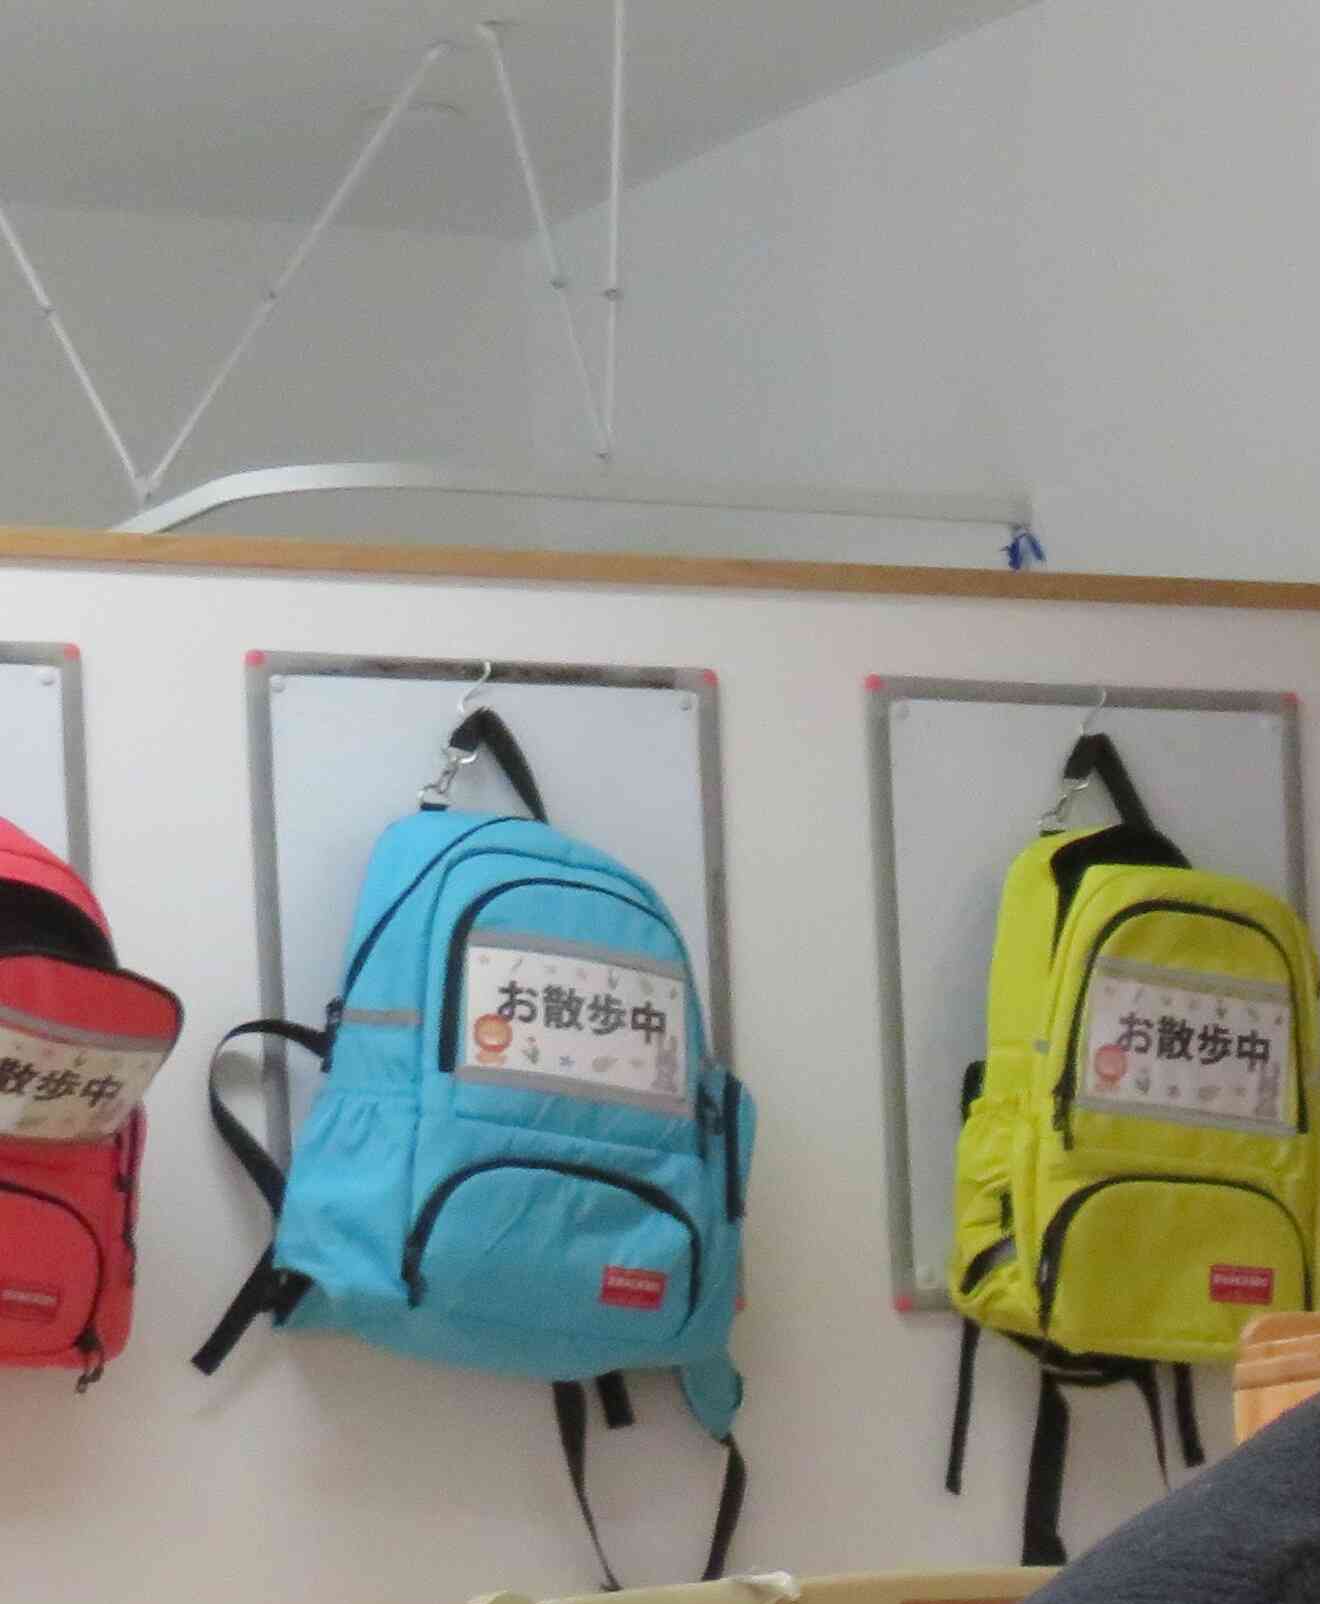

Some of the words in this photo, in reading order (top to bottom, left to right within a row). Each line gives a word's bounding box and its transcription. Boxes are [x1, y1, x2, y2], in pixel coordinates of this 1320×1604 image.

[498, 980, 667, 1044] お散歩中
[1117, 1011, 1271, 1072] お散歩中
